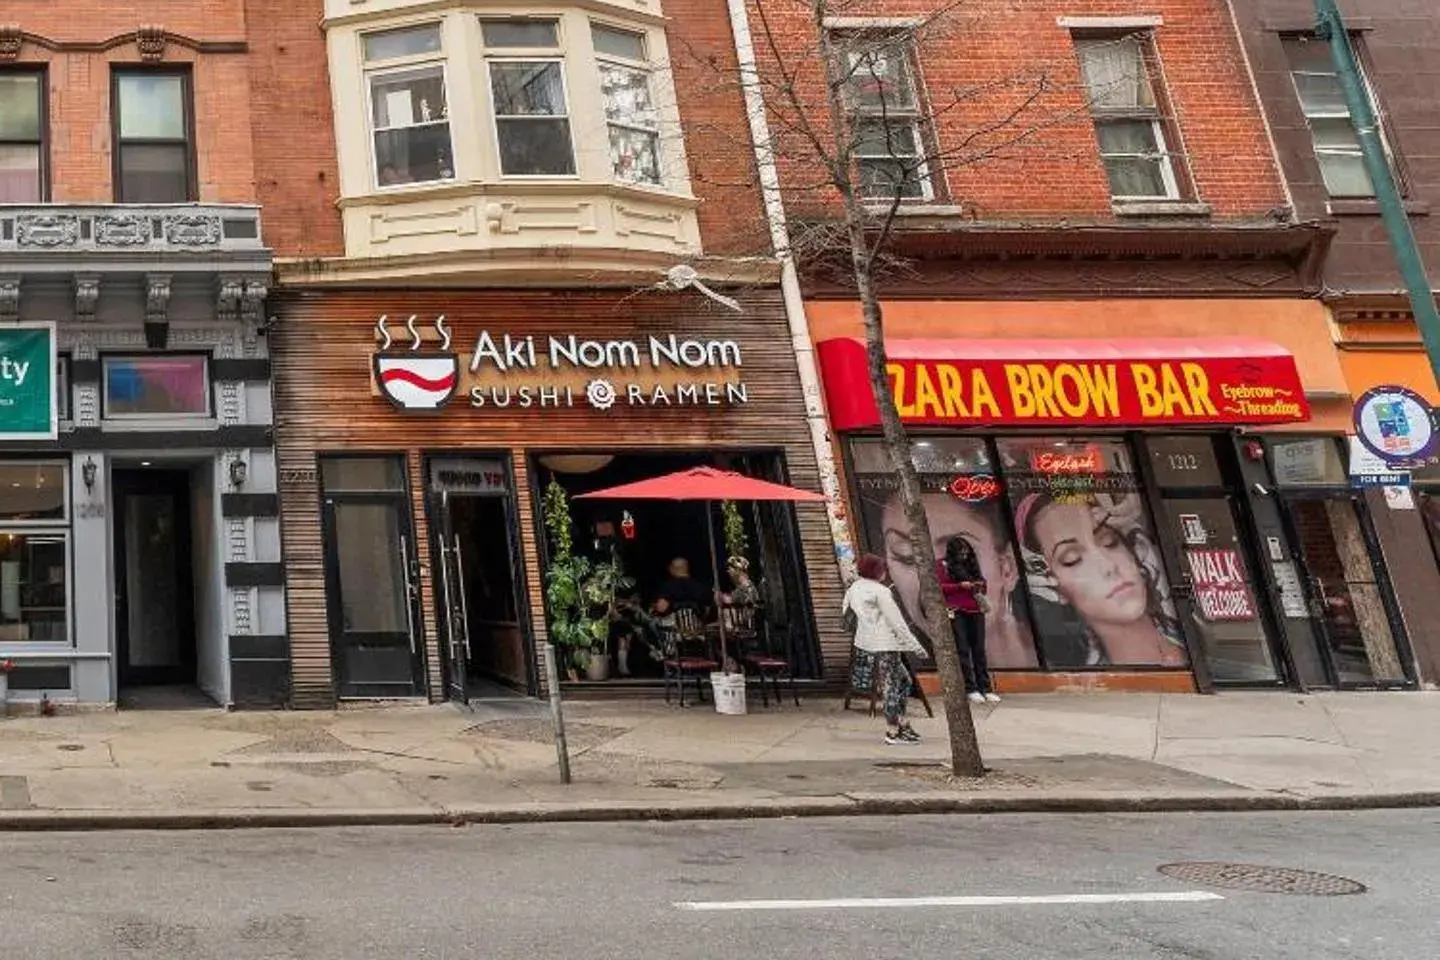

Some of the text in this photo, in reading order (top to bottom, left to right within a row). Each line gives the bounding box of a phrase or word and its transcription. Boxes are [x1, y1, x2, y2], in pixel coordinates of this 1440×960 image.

[470, 330, 741, 371] Aki Nom Nom
[470, 383, 748, 408] SUSHI RAMEN
[886, 362, 1218, 418] ZARA BROW BAR
[1220, 383, 1274, 401] Eyebrow
[1237, 399, 1302, 418] Threading
[1187, 551, 1243, 583] WALK
